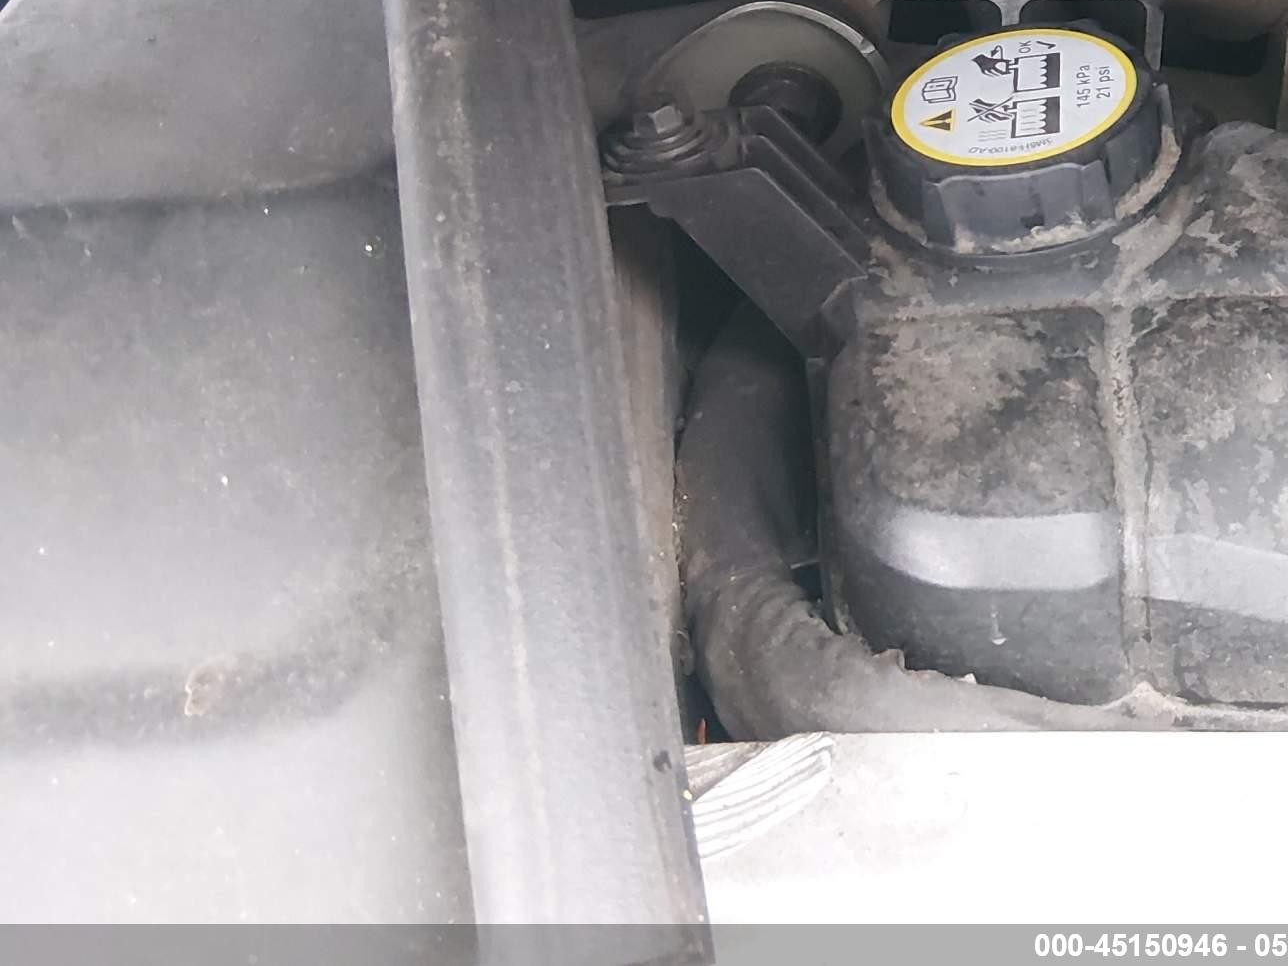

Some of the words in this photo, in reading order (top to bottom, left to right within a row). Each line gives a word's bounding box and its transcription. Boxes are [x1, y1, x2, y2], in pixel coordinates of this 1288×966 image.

[1018, 40, 1033, 54] OK
[1077, 64, 1091, 86] kPa
[1097, 65, 1115, 83] psi
[1076, 87, 1091, 110] 145
[1096, 83, 1111, 100] 21
